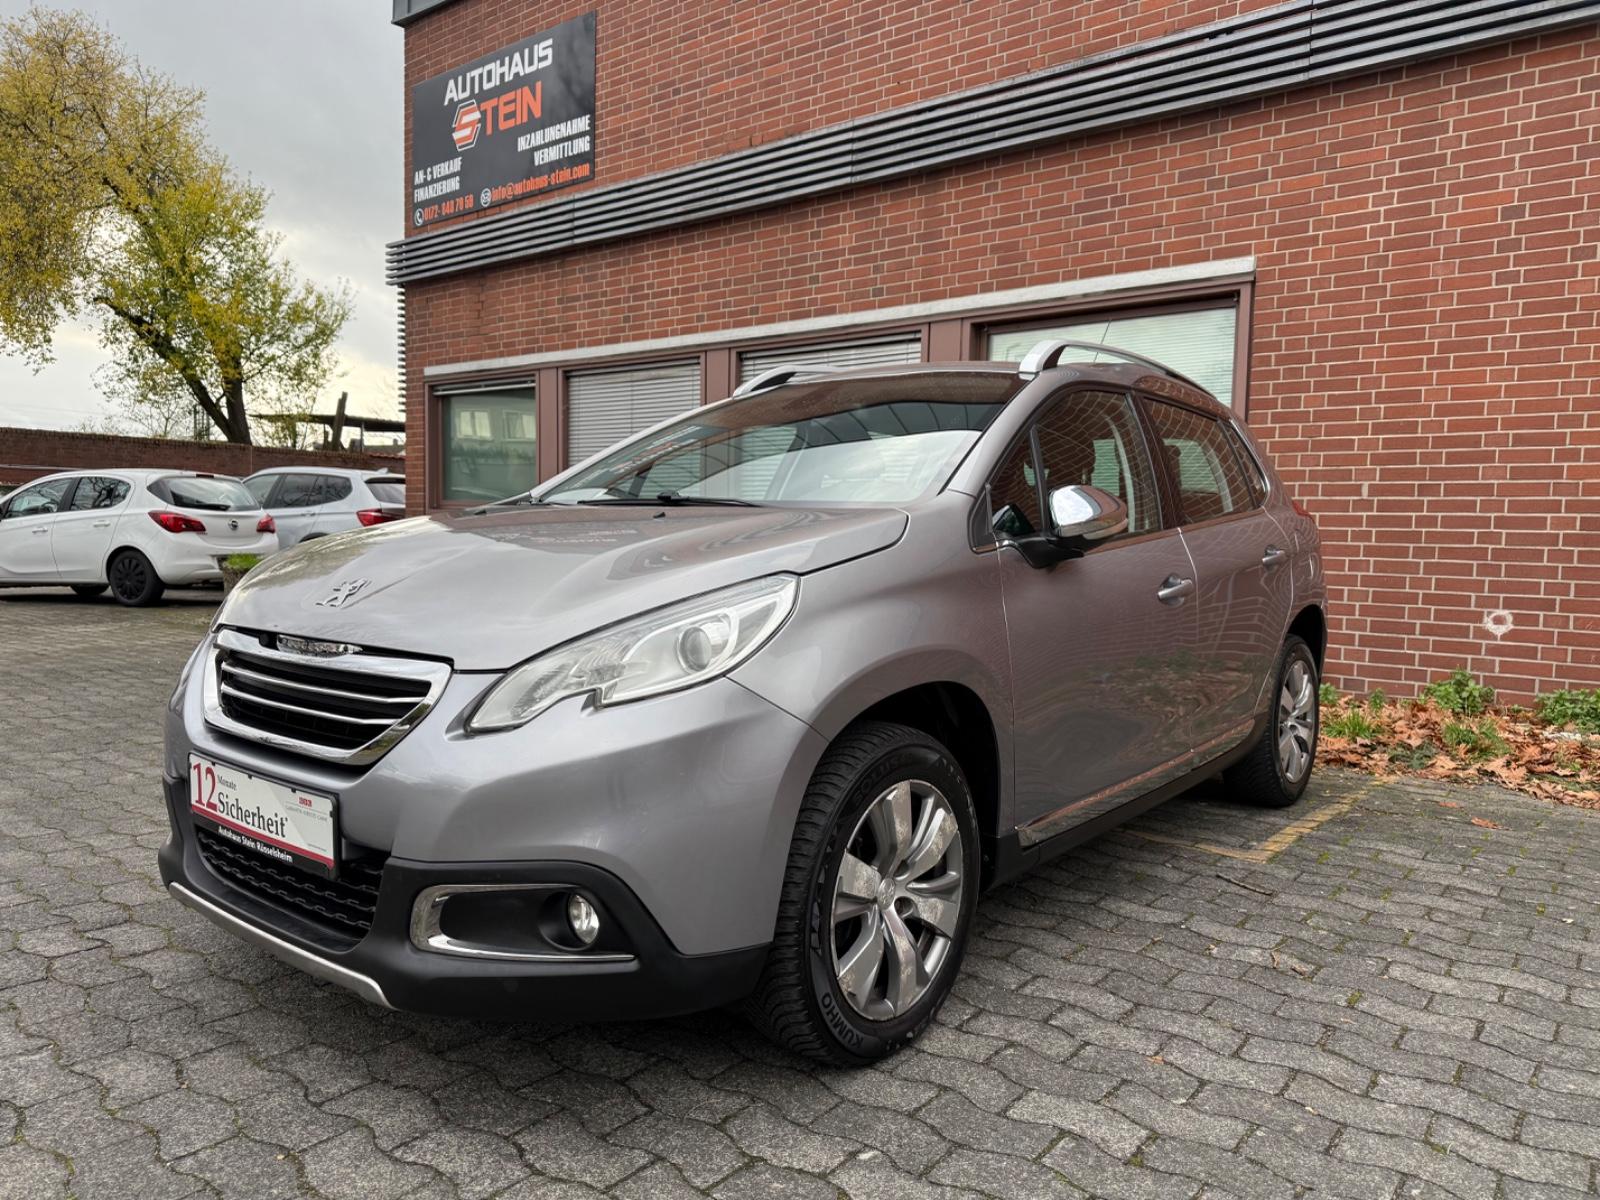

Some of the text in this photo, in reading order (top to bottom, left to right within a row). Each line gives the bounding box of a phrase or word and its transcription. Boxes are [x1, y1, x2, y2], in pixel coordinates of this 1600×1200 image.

[444, 38, 553, 106] AUTOHAUS
[452, 81, 542, 151] STEIN
[517, 114, 591, 152] INZAHLUNGNAHME
[432, 156, 462, 179] VERKAUF
[534, 135, 590, 166] VERMITTLUNG
[414, 175, 460, 203] FINANZIERUNG
[491, 162, 590, 201] info@autohaus-stein.com
[193, 762, 218, 813] 12
[218, 825, 241, 844] Autohaus
[241, 835, 256, 849] Stein
[821, 991, 864, 1047] KUMHO
